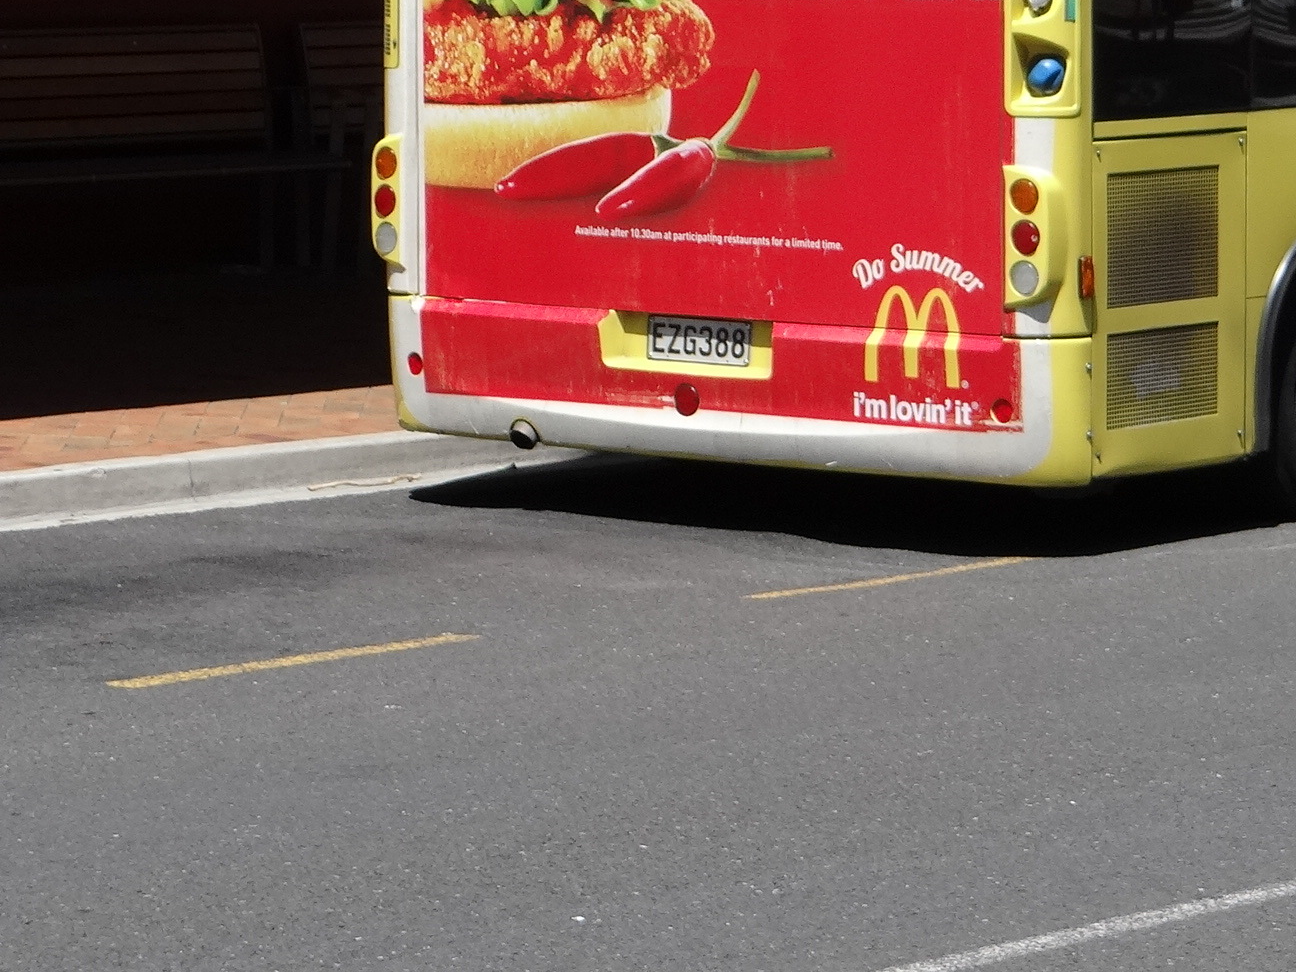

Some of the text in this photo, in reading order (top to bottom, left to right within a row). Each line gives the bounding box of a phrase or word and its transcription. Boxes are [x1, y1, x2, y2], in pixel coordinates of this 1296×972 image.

[574, 224, 844, 251] Available after 10.30am at participating restaurants for a limited time.
[852, 243, 985, 293] Do Summer
[652, 321, 746, 359] EZG388
[853, 392, 888, 419] i'm
[889, 394, 951, 425] lovin'
